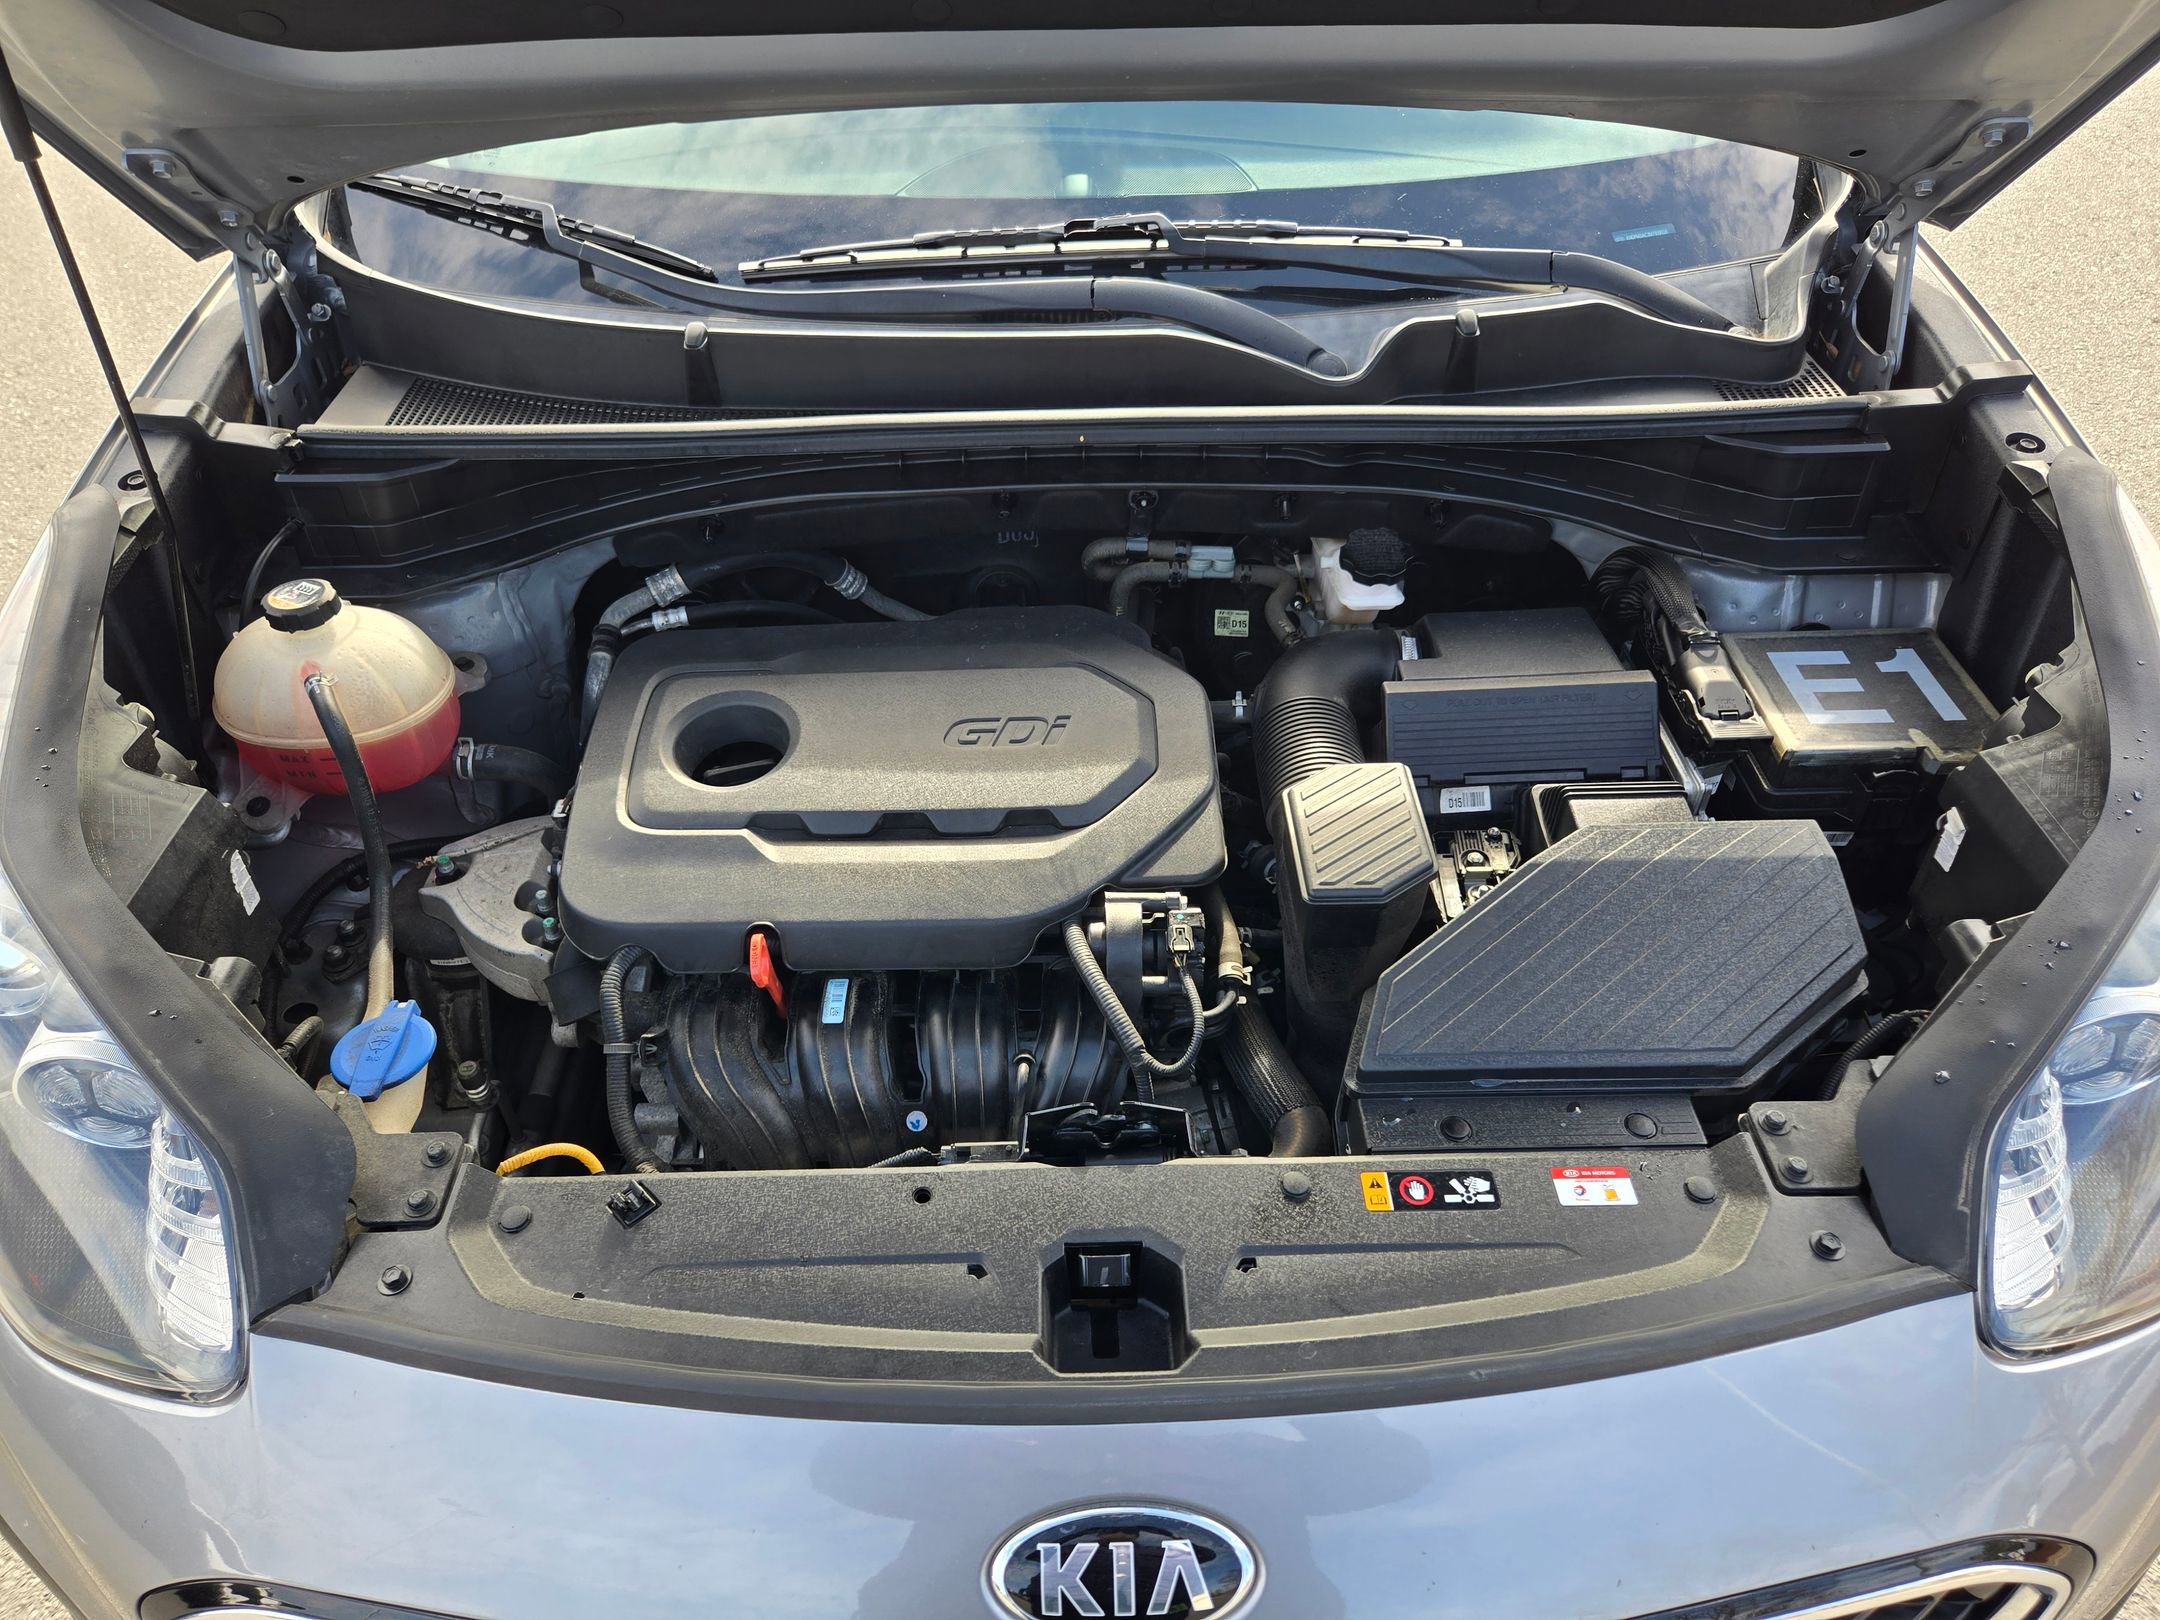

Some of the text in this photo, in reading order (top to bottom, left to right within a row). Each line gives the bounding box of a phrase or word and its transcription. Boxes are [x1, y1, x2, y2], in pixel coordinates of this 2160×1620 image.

[1231, 619, 1248, 629] D15
[1766, 647, 1968, 725] E1
[1448, 797, 1463, 809] D15
[1036, 1539, 1215, 1617] KIA
